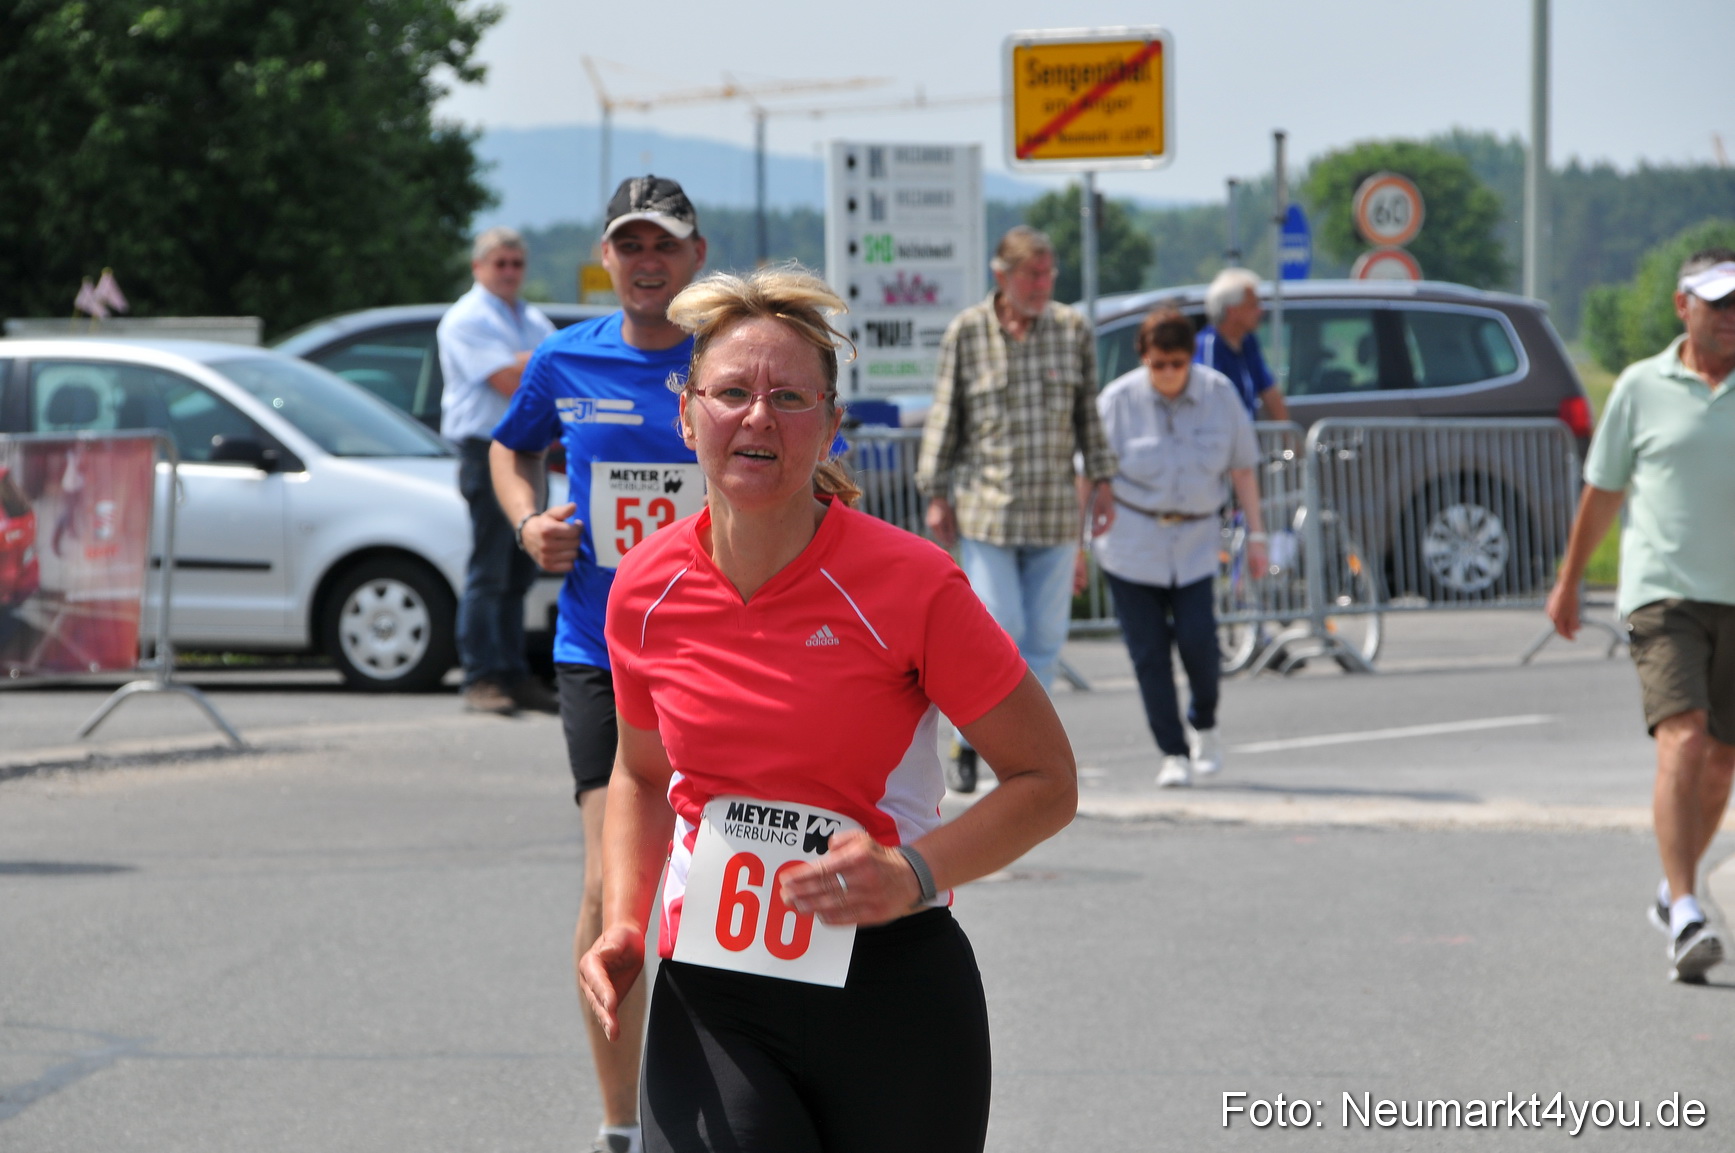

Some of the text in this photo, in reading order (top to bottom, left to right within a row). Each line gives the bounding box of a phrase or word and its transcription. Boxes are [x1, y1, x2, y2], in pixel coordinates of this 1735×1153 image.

[1373, 196, 1408, 225] 60
[609, 468, 659, 482] MEYER
[609, 481, 661, 493] WERBUNG
[805, 636, 840, 647] adidas
[725, 801, 801, 832] MEYER
[723, 821, 798, 847] WERBUNG
[715, 851, 816, 961] 66
